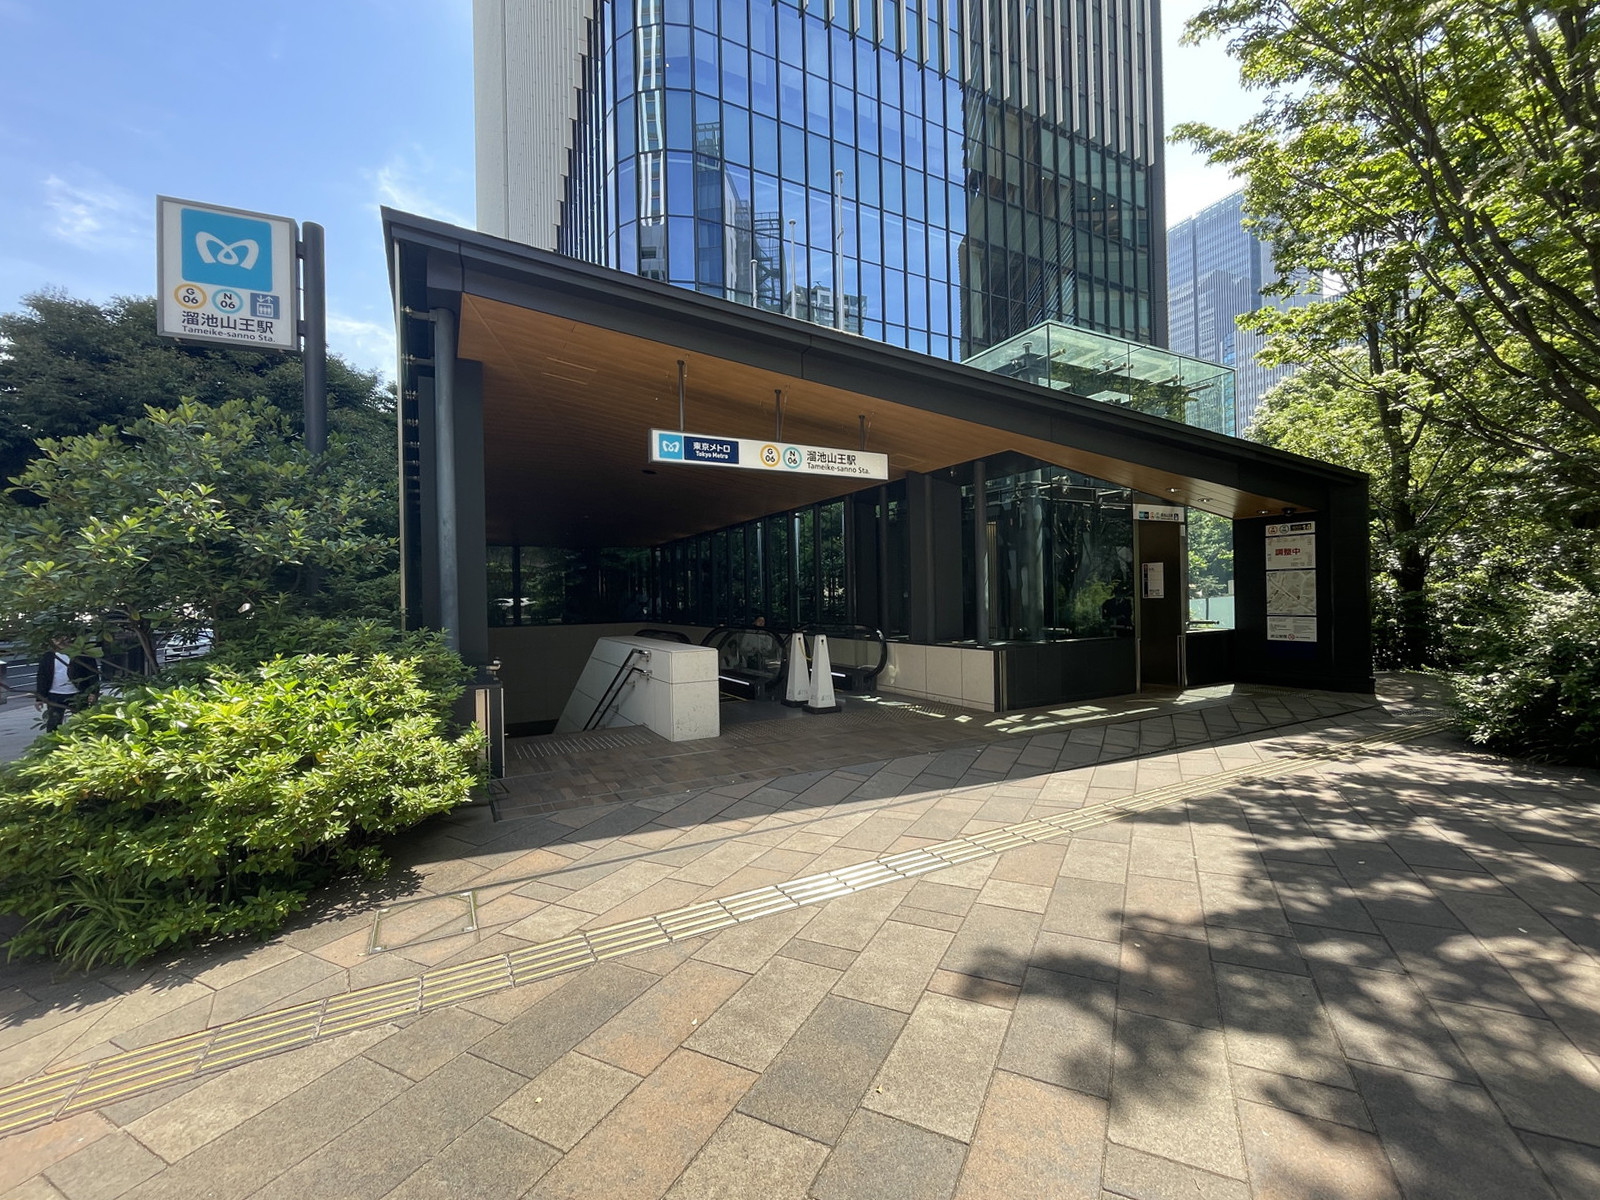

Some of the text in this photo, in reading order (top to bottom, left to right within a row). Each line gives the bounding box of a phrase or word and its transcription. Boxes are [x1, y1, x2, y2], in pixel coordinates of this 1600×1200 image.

[182, 295, 199, 304] 06
[220, 300, 236, 309] 06
[181, 310, 274, 335] 溜池山王駅
[182, 325, 276, 343] Tameike-sanno Sta.
[692, 441, 731, 453] 東京メトロ
[695, 450, 712, 459] Tokyo
[765, 454, 776, 463] 06
[806, 450, 857, 466] 溜池山王駅
[787, 457, 798, 465] 06
[807, 462, 871, 475] Tameike-sanno Sta.
